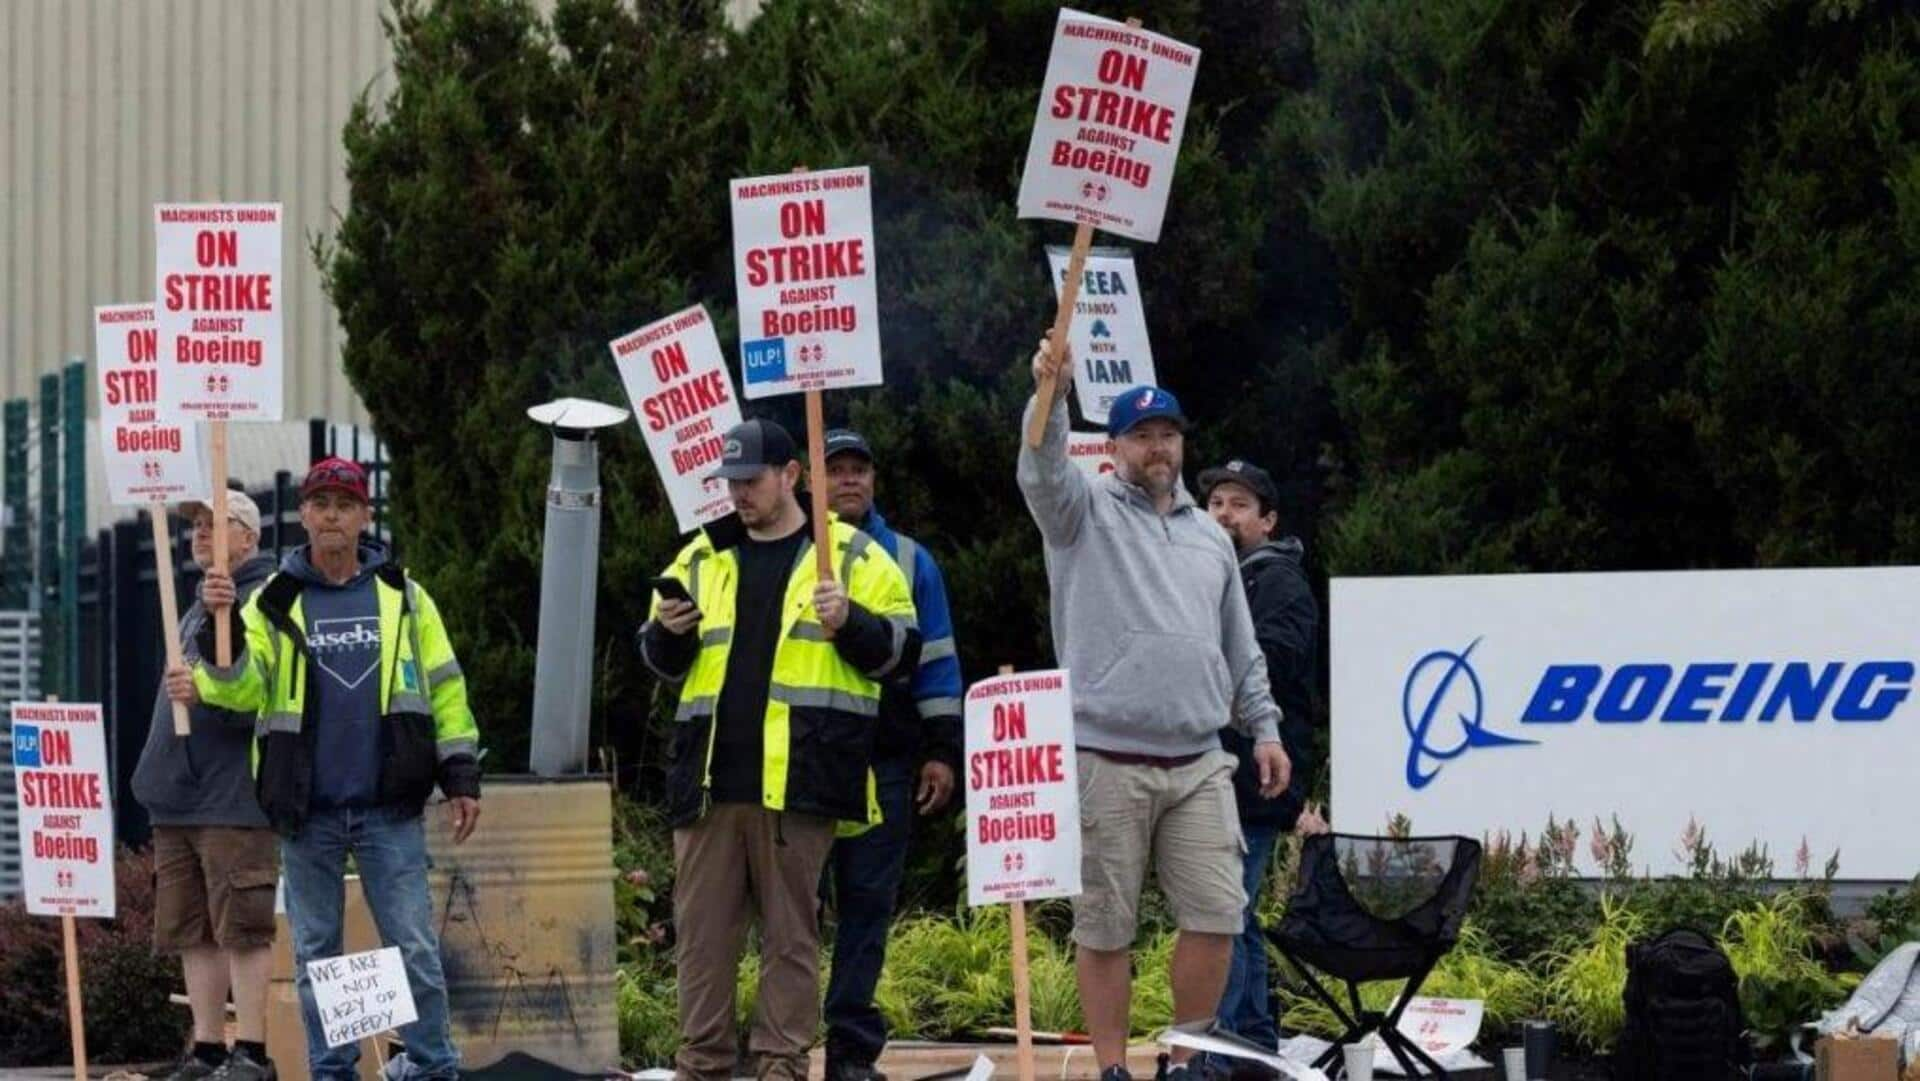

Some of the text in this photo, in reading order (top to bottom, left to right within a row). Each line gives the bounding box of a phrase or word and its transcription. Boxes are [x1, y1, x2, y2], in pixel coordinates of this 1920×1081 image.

[1063, 22, 1193, 66] MACHINISTS UNION
[1098, 49, 1148, 92] ON
[1051, 85, 1175, 144] STRIKE
[1077, 127, 1137, 152] AGAINST
[1051, 140, 1151, 189] Boeing
[738, 174, 865, 199] MACHINISTS UNION
[161, 209, 277, 223] MACHINISTS UNION
[780, 200, 825, 239] ON
[196, 230, 237, 268] ON
[746, 240, 865, 287] STRIKE
[165, 274, 272, 311] STRIKE
[780, 285, 836, 305] AGAINST
[1076, 302, 1116, 315] STANDS
[99, 310, 155, 323] MACHINISTS
[192, 318, 244, 333] AGAINST
[617, 309, 706, 356] MACHINISTS UNION
[763, 304, 857, 337] Boeing
[128, 329, 157, 363] ON
[176, 335, 262, 367] Boeing
[651, 341, 689, 383] ON
[748, 348, 781, 368] ULP!
[1090, 343, 1116, 353] WITH
[105, 369, 157, 406] STRI
[1086, 359, 1133, 384] IAM
[643, 369, 729, 432] STRIKE
[116, 426, 181, 454] Boeing
[675, 417, 713, 443] AGAINST
[672, 433, 724, 475] Boein
[971, 676, 1062, 698] MACHINISTS UNION
[1520, 661, 1915, 724] BOEING
[16, 708, 97, 722] MACHINISTS UNION
[992, 701, 1026, 743] ON
[41, 729, 72, 767] ON
[970, 745, 1064, 791] STRIKE
[22, 772, 102, 810] STRIKE
[990, 791, 1035, 810] AGAINST
[43, 815, 82, 830] AGAINST
[978, 811, 1056, 845] Boeing
[33, 831, 98, 863] Boeing
[311, 952, 378, 982] WE ARE
[342, 974, 379, 995] NOT
[329, 1009, 394, 1043] GREEDY
